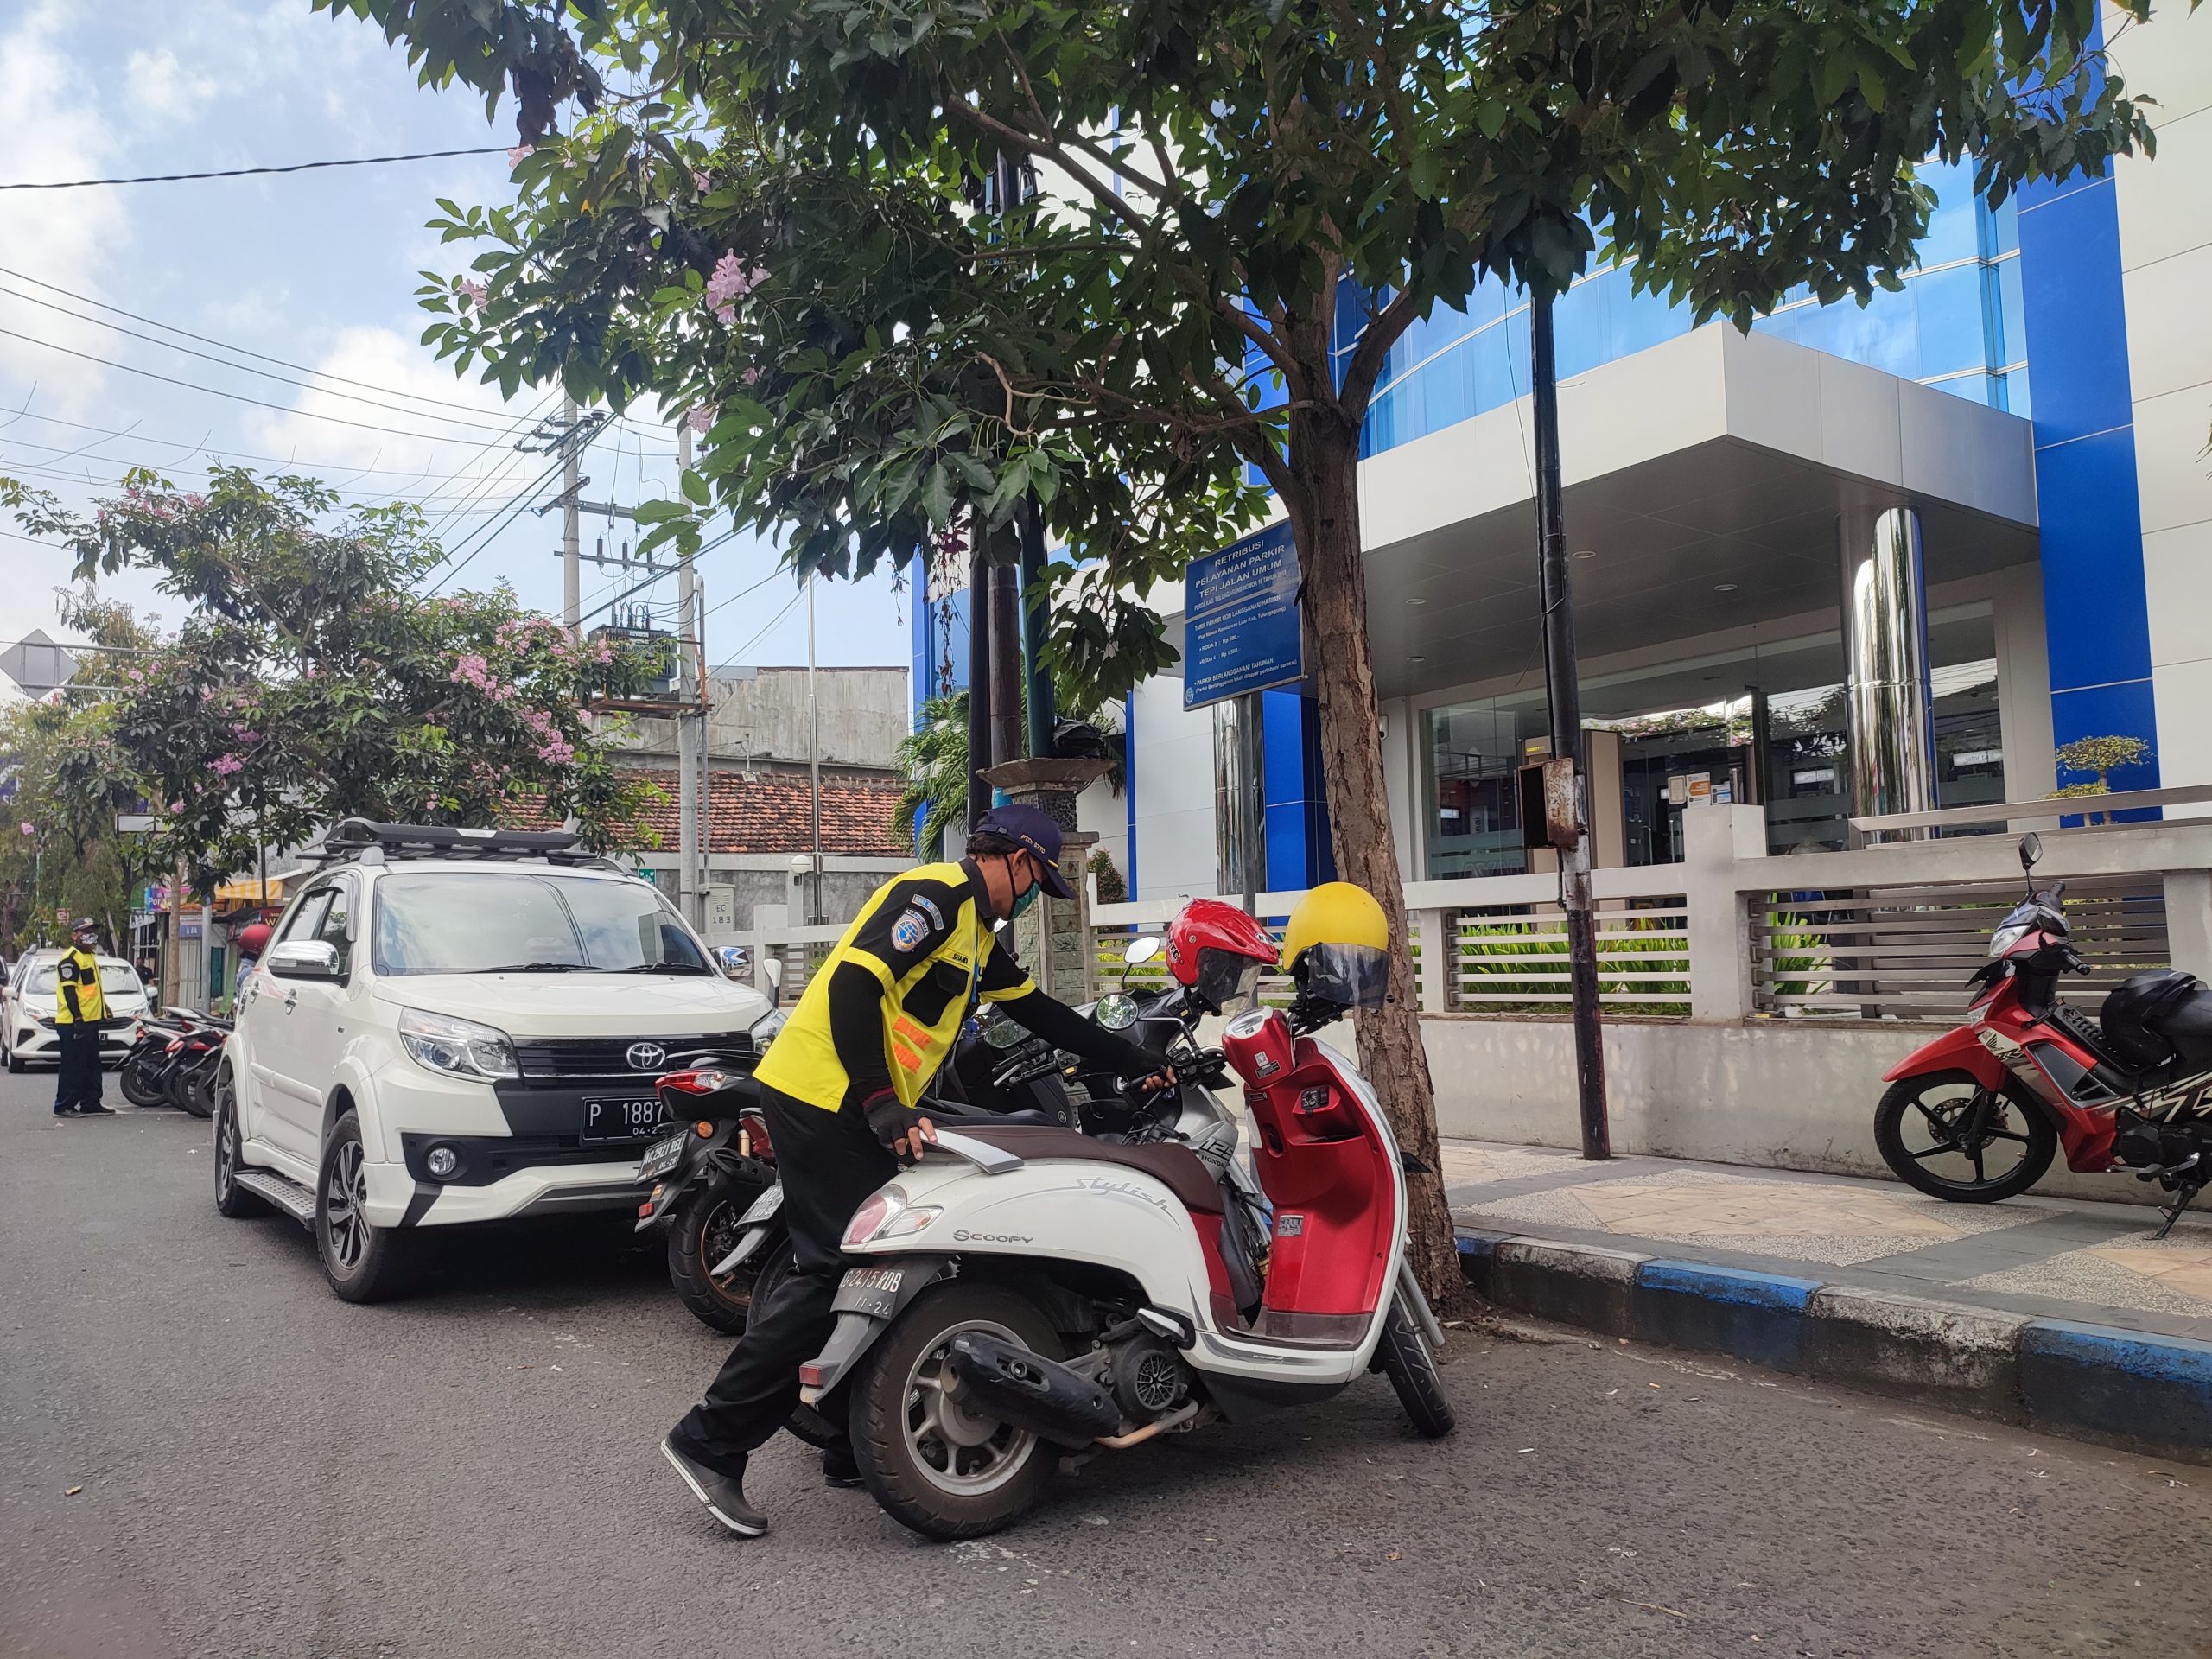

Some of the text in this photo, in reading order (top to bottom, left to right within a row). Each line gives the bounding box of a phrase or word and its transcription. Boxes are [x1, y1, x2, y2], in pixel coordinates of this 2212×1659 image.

[1196, 544, 1285, 588] PELAYANAN PARKIR
[1215, 540, 1264, 567] RETRIBUSI
[1199, 559, 1282, 599] TEPI JALAN UMUM
[1206, 616, 1222, 628] PARKIR
[1222, 612, 1232, 621] NON
[1197, 676, 1212, 685] PARKIR
[1251, 658, 1274, 669] TAHUNAN
[716, 904, 726, 912] EC
[589, 1101, 664, 1127] P 1887
[1201, 1154, 1224, 1168] HONDA
[849, 1269, 880, 1288] 2415
[874, 1271, 902, 1293] RDB
